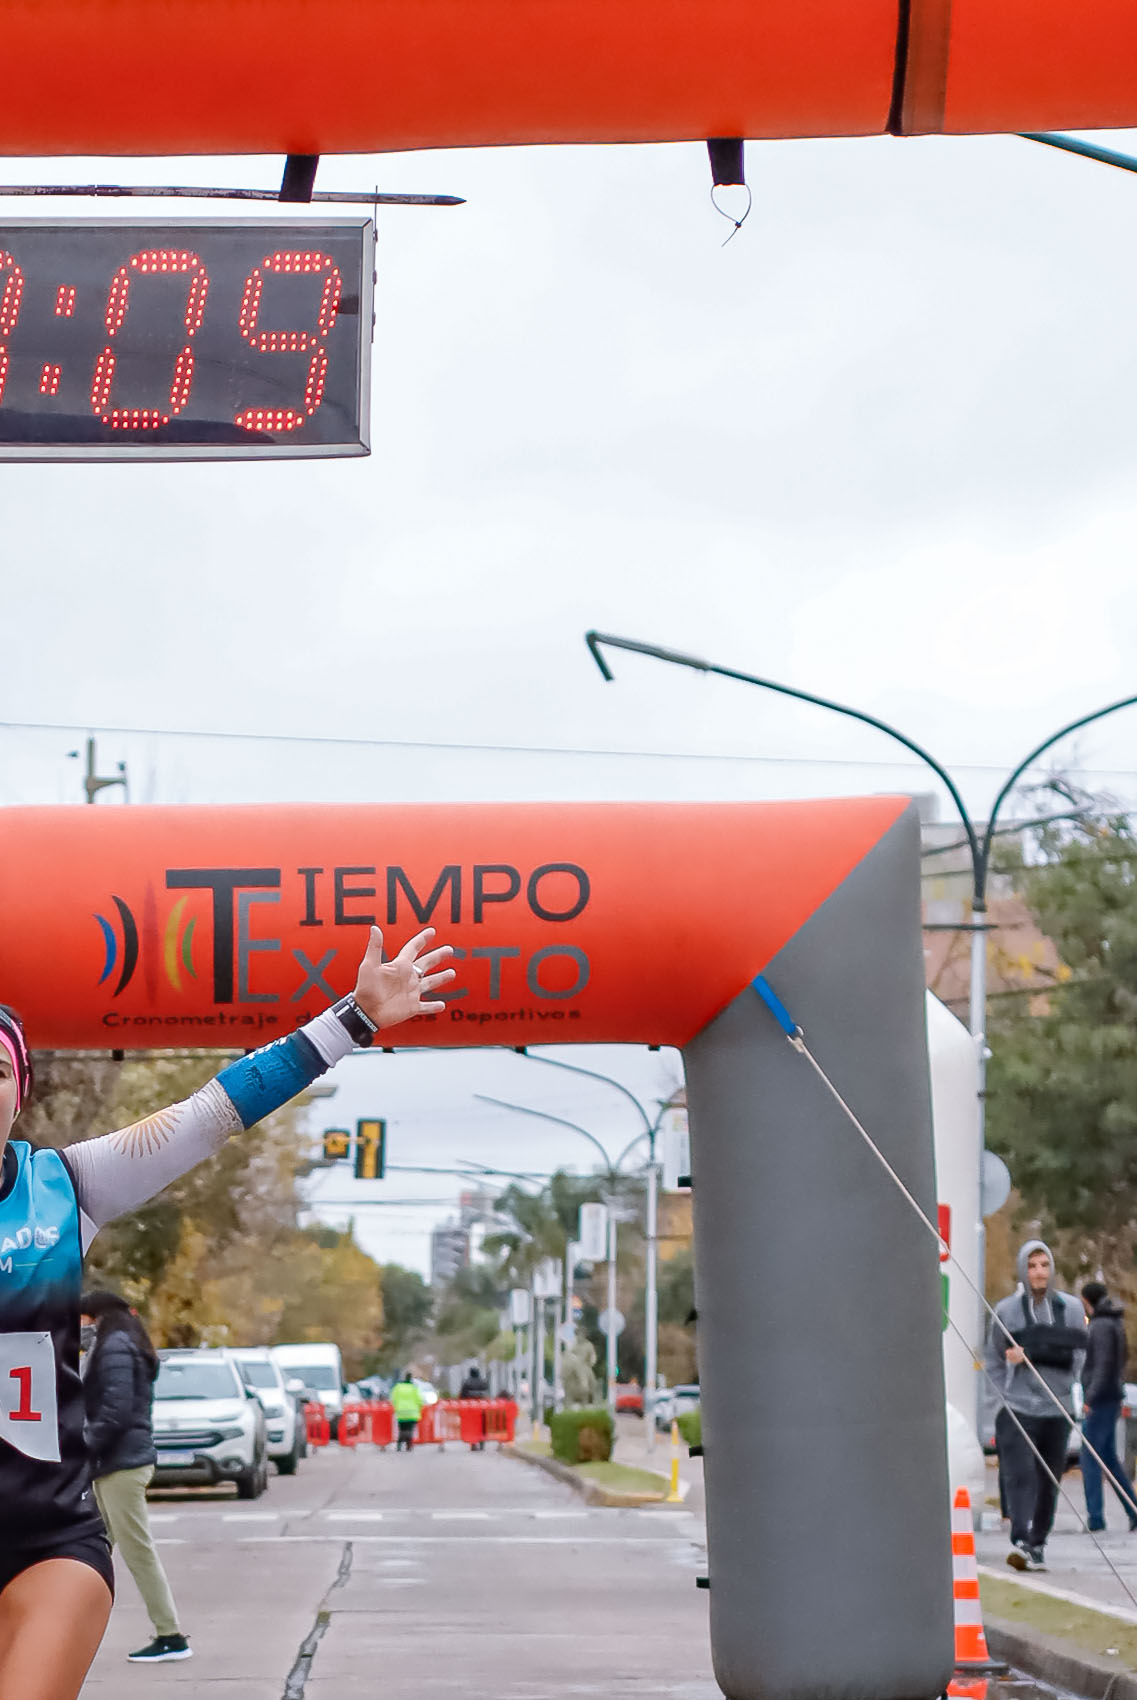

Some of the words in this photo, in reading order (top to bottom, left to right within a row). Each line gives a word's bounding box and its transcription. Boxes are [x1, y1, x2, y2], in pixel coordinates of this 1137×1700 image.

[166, 863, 591, 1004] TIEMPO
[238, 892, 591, 1003] EXCTO
[102, 1012, 278, 1027] Cronometraje
[450, 1008, 581, 1024] Deportivos
